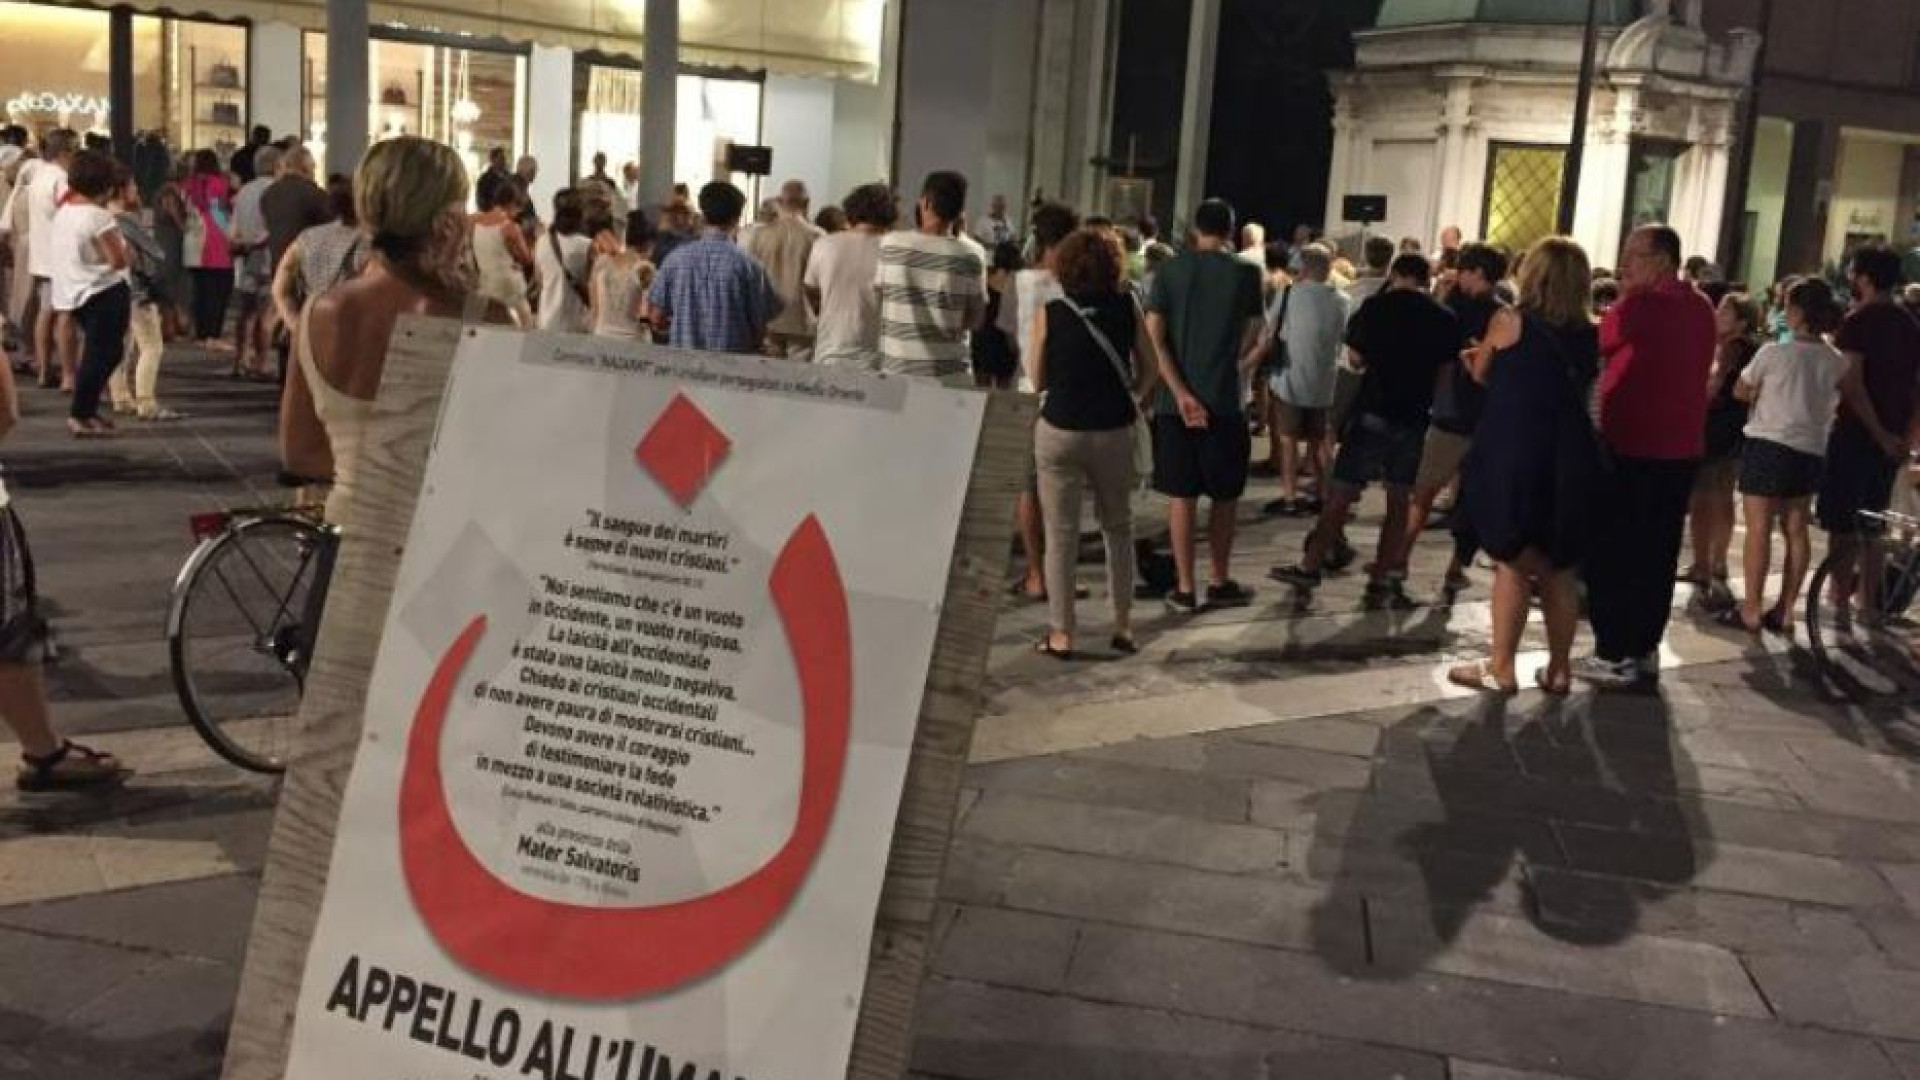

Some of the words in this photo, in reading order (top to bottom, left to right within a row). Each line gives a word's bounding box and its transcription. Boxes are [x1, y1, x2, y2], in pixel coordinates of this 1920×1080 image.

[564, 527, 574, 547] è
[575, 536, 612, 553] seme
[614, 539, 628, 555] di
[630, 543, 668, 562] nuovi
[603, 516, 651, 537] sangue
[654, 523, 676, 541] dei
[679, 529, 729, 551] martiri
[528, 599, 542, 614] in
[544, 601, 612, 631] Occidente,
[614, 616, 633, 631] un
[635, 619, 674, 640] vuoto
[676, 626, 743, 653] religioso.
[570, 583, 631, 608] sentiamo
[634, 596, 658, 613] che
[661, 599, 682, 616] c'è
[684, 605, 702, 619] un
[705, 607, 745, 628] vuoto
[511, 639, 521, 658] è
[522, 646, 556, 665] stata
[557, 652, 583, 669] una
[586, 656, 628, 680] laicità
[630, 665, 671, 688] molto
[673, 672, 737, 701] negativa.
[548, 624, 565, 643] La
[567, 627, 608, 651] laicità
[610, 638, 711, 671] all'occidentale
[474, 681, 488, 698] di
[489, 687, 514, 703] non
[516, 692, 554, 711] avere
[556, 699, 597, 721] paura
[599, 707, 613, 724] di
[614, 713, 683, 739] mostrarsi
[519, 666, 566, 690] Chiedo
[567, 676, 582, 693] ai
[584, 682, 640, 706] cristiani
[642, 693, 718, 722] occidentali
[524, 715, 573, 740] Devono
[574, 728, 614, 750] avere
[615, 734, 627, 752] il
[628, 738, 691, 768] coraggio
[524, 740, 540, 758] di
[541, 745, 626, 777] testimoniare
[629, 762, 643, 780] la
[644, 765, 676, 789] fede
[476, 752, 490, 770] in
[491, 758, 535, 781] mezzo
[535, 769, 544, 784] a
[546, 772, 573, 789] una
[574, 776, 623, 802] società
[517, 834, 563, 862] Mater
[563, 846, 641, 882] Salvatoris
[326, 955, 523, 1068] APPELLO
